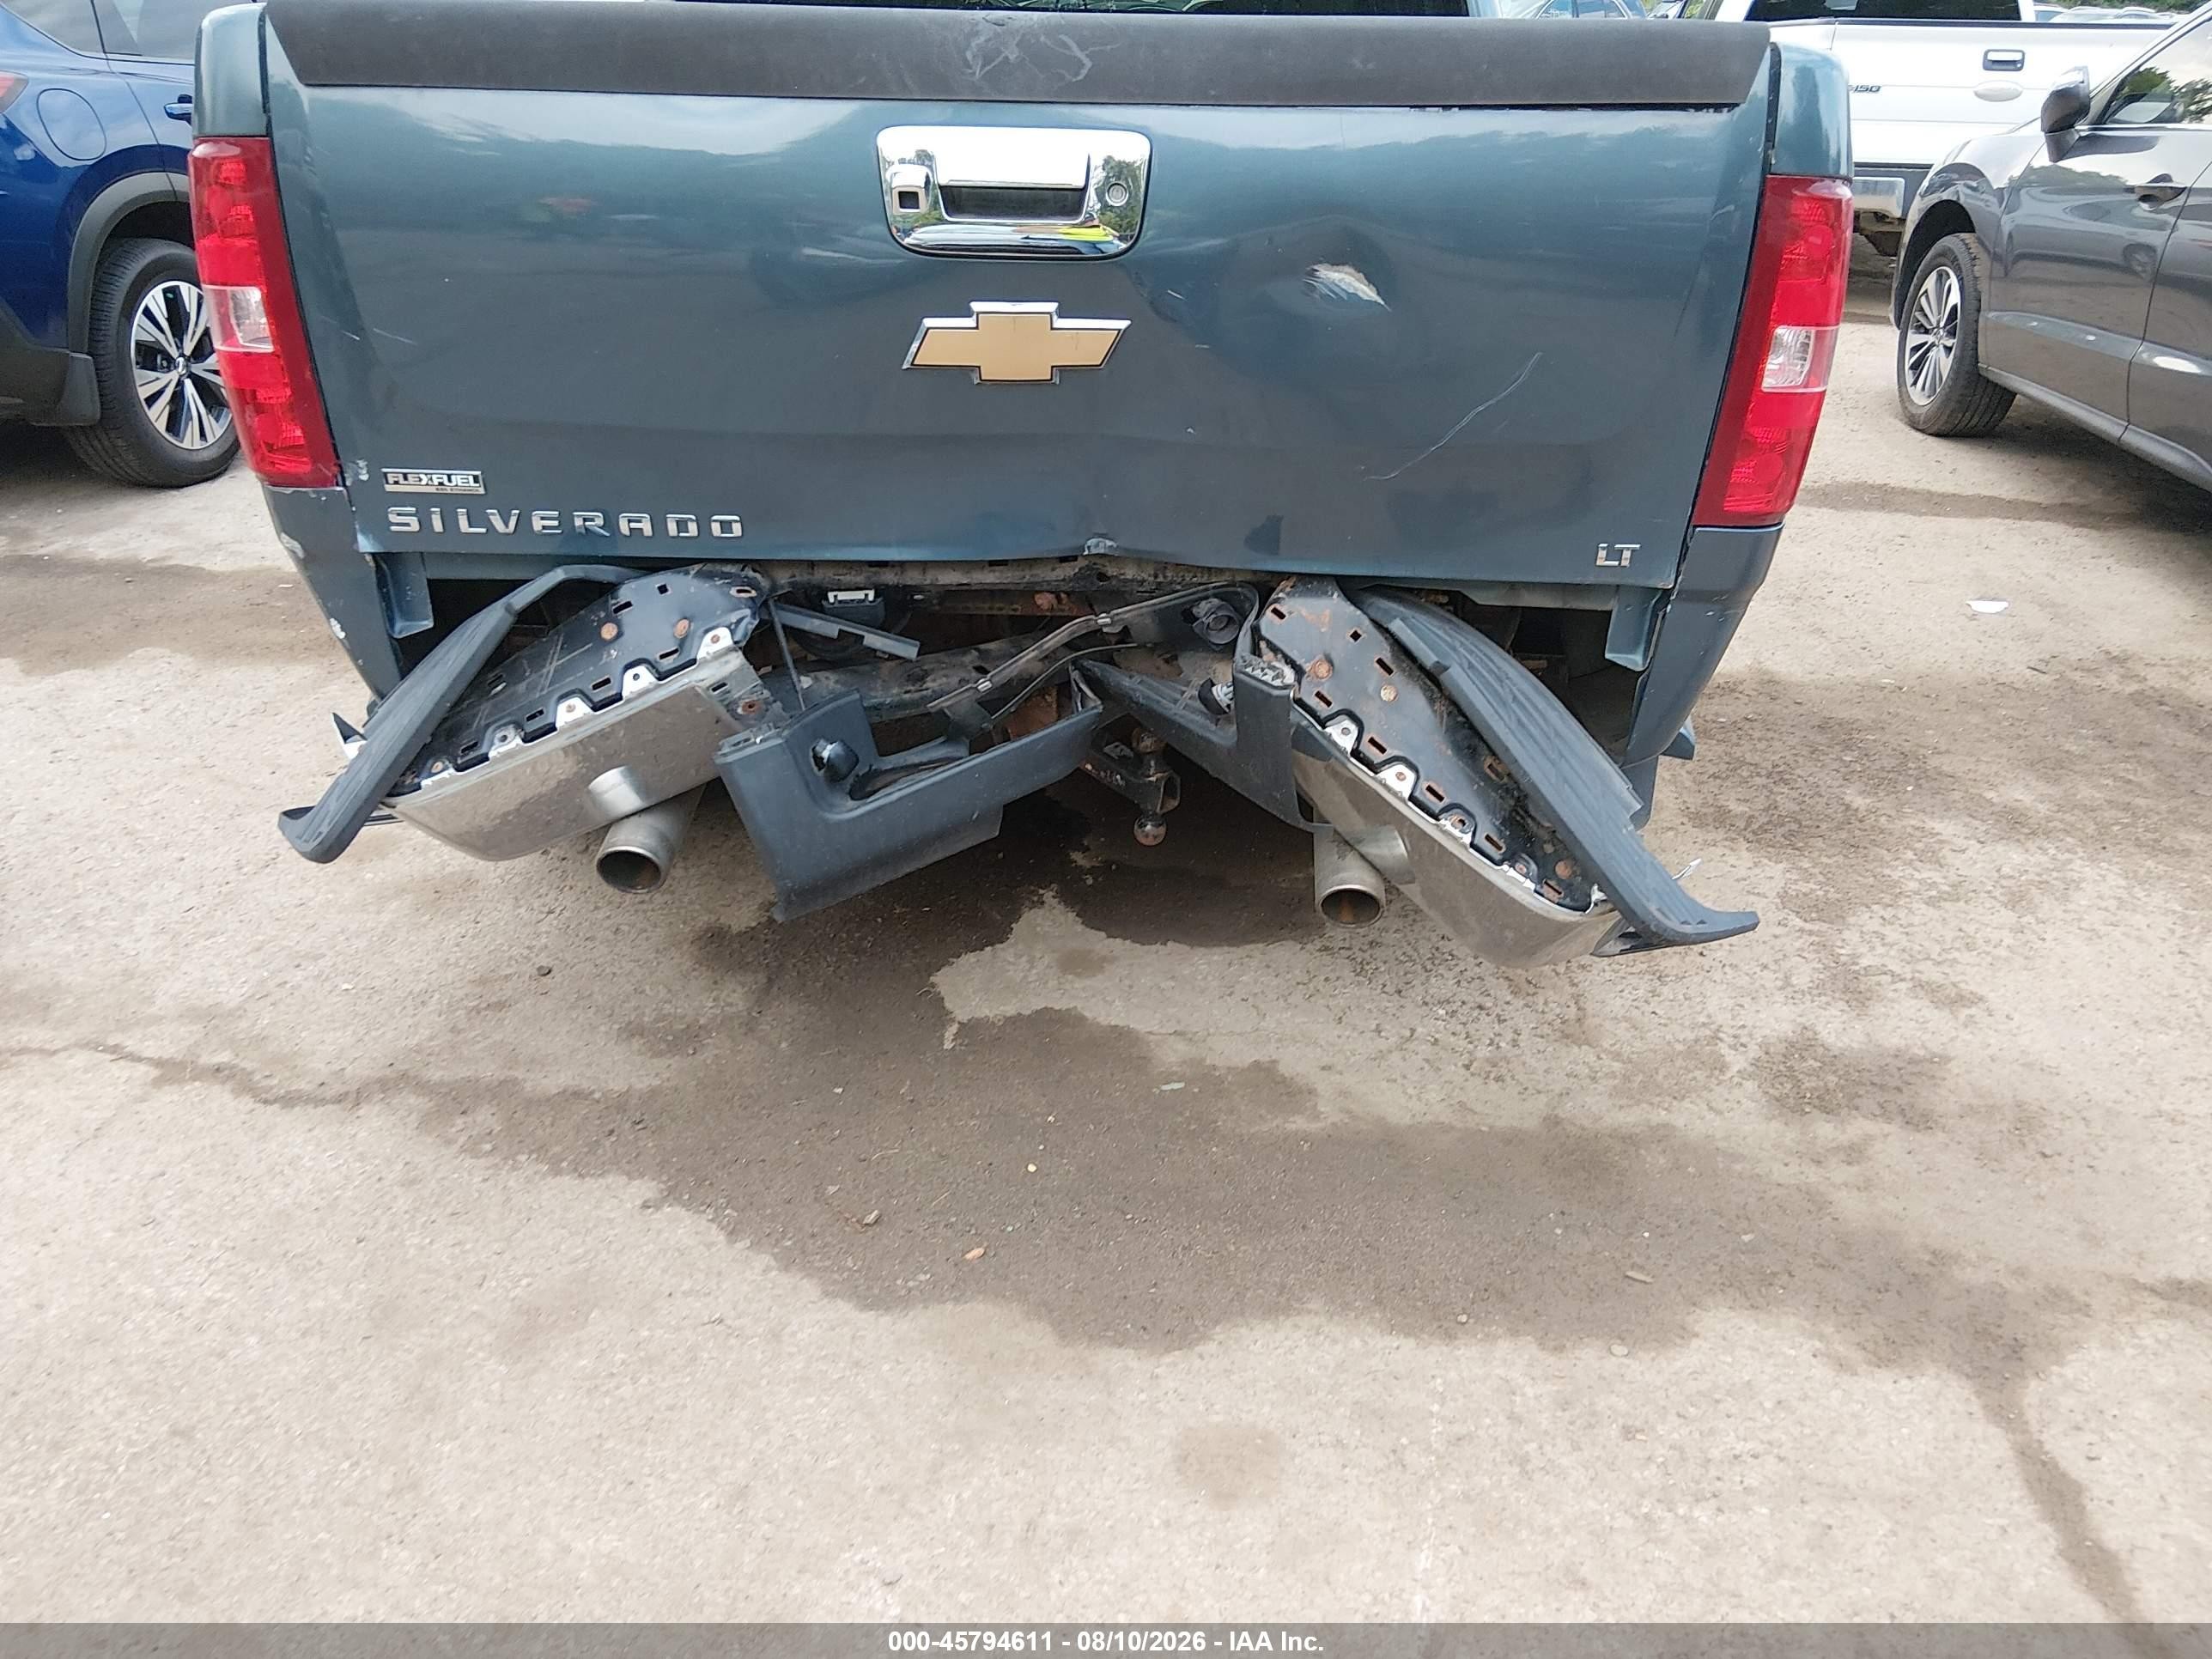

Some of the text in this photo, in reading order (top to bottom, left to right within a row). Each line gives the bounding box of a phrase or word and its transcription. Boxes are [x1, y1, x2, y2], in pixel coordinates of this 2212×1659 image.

[386, 472, 480, 487] FLEXFUEL
[387, 506, 744, 538] SILVERADO
[1595, 543, 1642, 568] LT
